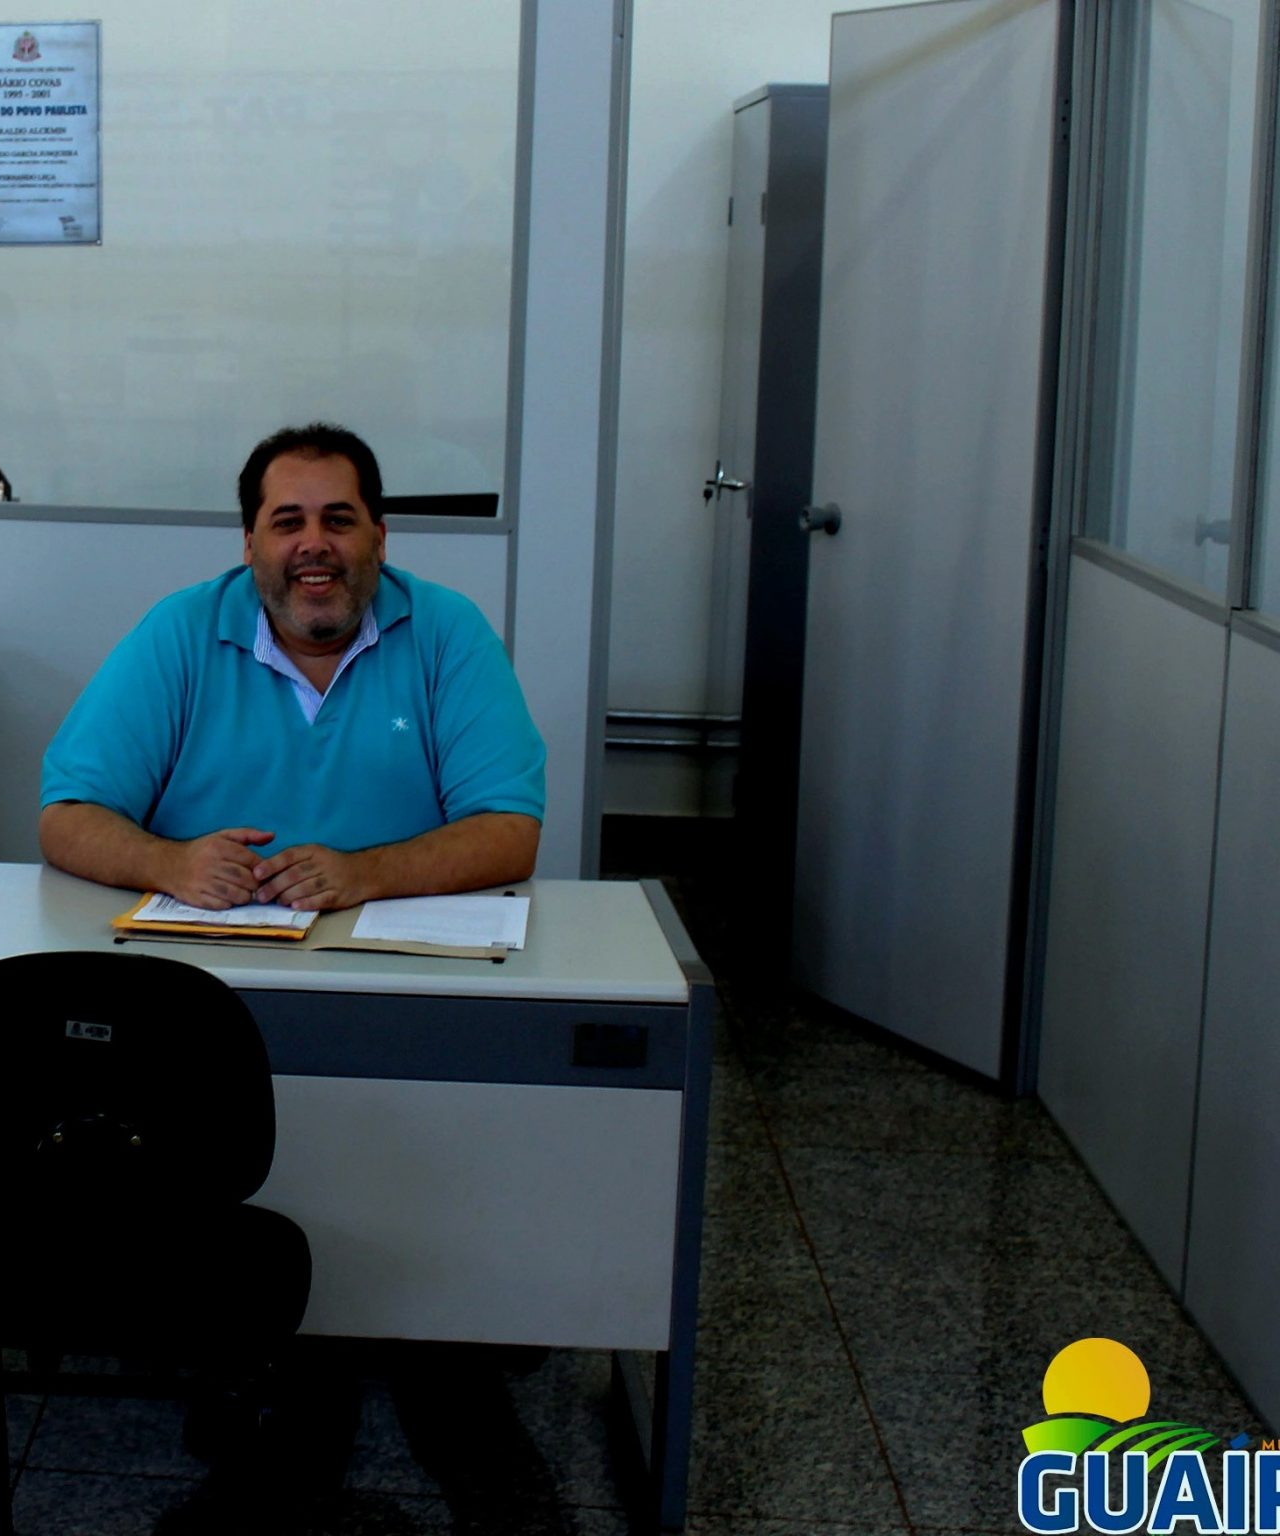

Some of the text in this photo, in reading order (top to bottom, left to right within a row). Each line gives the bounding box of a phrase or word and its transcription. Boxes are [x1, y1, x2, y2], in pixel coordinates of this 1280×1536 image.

[28, 78, 62, 87] COVAS
[3, 90, 22, 98] 1995
[31, 90, 51, 98] 2001
[0, 106, 14, 116] DO
[16, 106, 42, 116] POVO
[45, 105, 87, 116] PAULISTA
